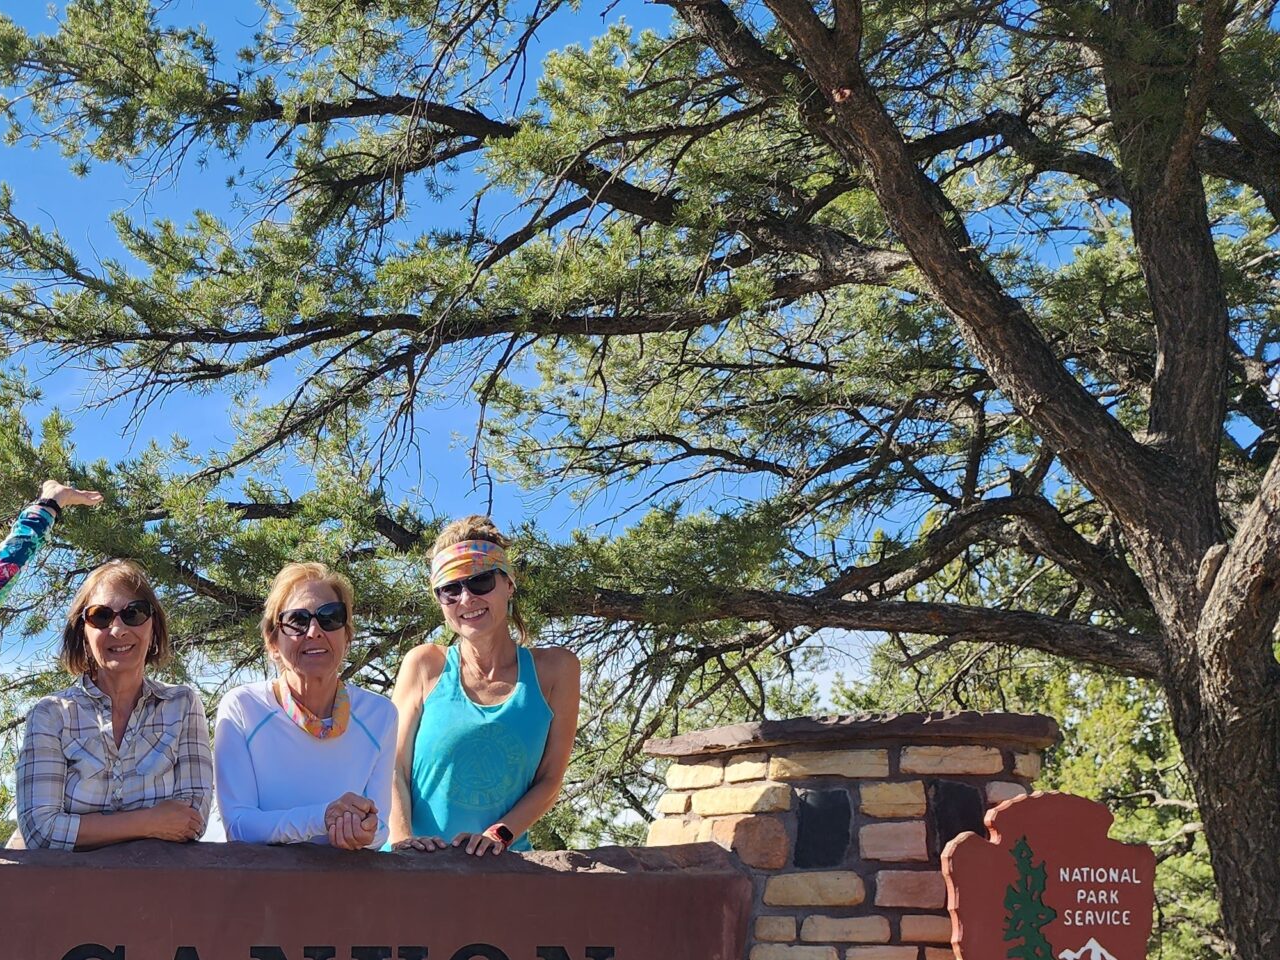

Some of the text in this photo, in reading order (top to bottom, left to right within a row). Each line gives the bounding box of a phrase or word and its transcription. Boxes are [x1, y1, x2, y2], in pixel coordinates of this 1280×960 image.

[1060, 867, 1140, 883] NATIONAL
[1077, 890, 1119, 904] PARK
[1064, 910, 1131, 925] SERVICE
